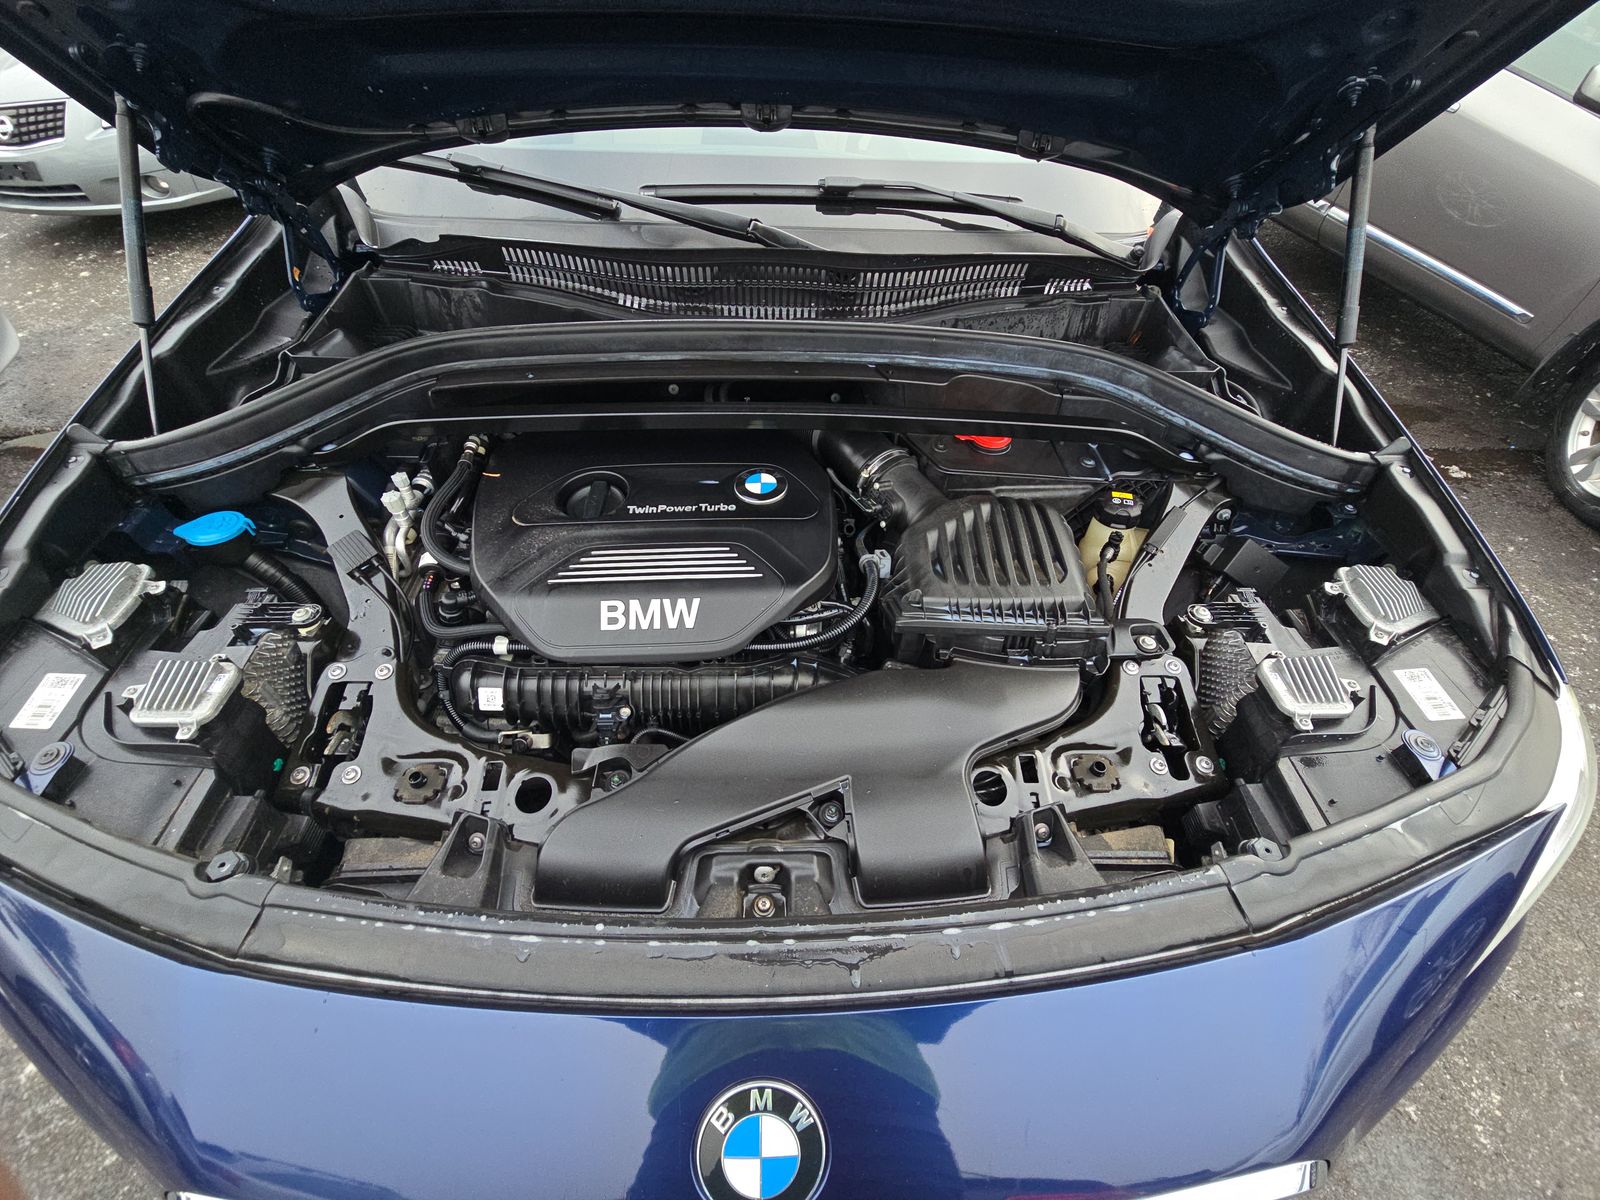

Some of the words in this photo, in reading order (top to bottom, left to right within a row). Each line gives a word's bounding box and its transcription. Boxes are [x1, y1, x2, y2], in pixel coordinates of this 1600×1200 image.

[699, 503, 737, 512] Turbo
[600, 598, 701, 631] BMW
[710, 1088, 815, 1135] BMW
